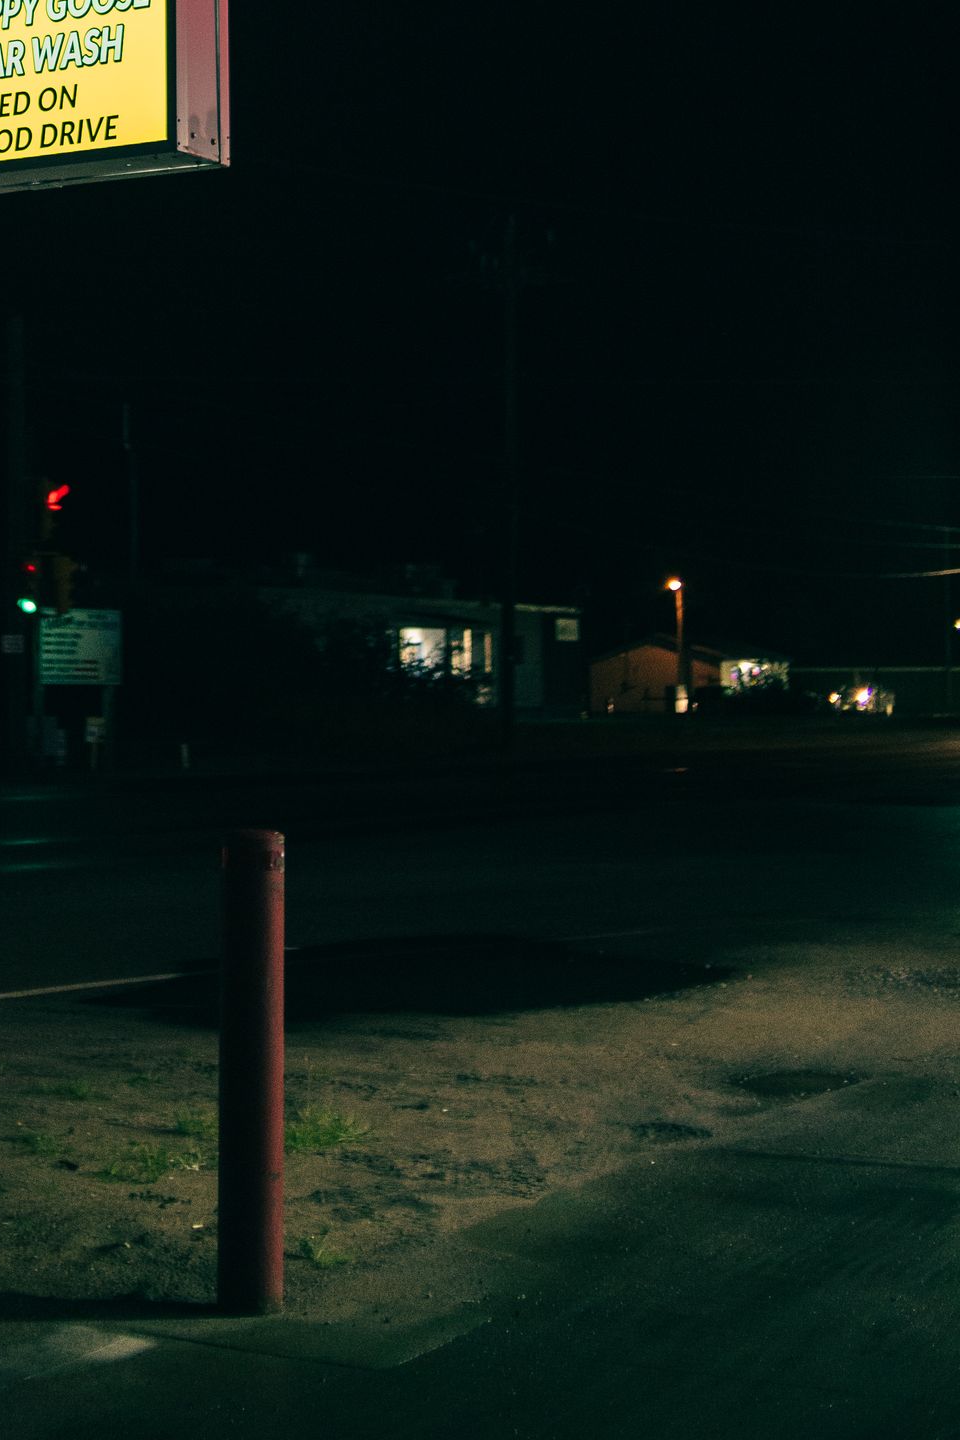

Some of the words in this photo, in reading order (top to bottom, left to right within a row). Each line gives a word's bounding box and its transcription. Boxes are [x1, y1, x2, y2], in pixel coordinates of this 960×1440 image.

[31, 24, 125, 74] WASH
[38, 83, 78, 112] ON
[39, 114, 120, 149] DRIVE
